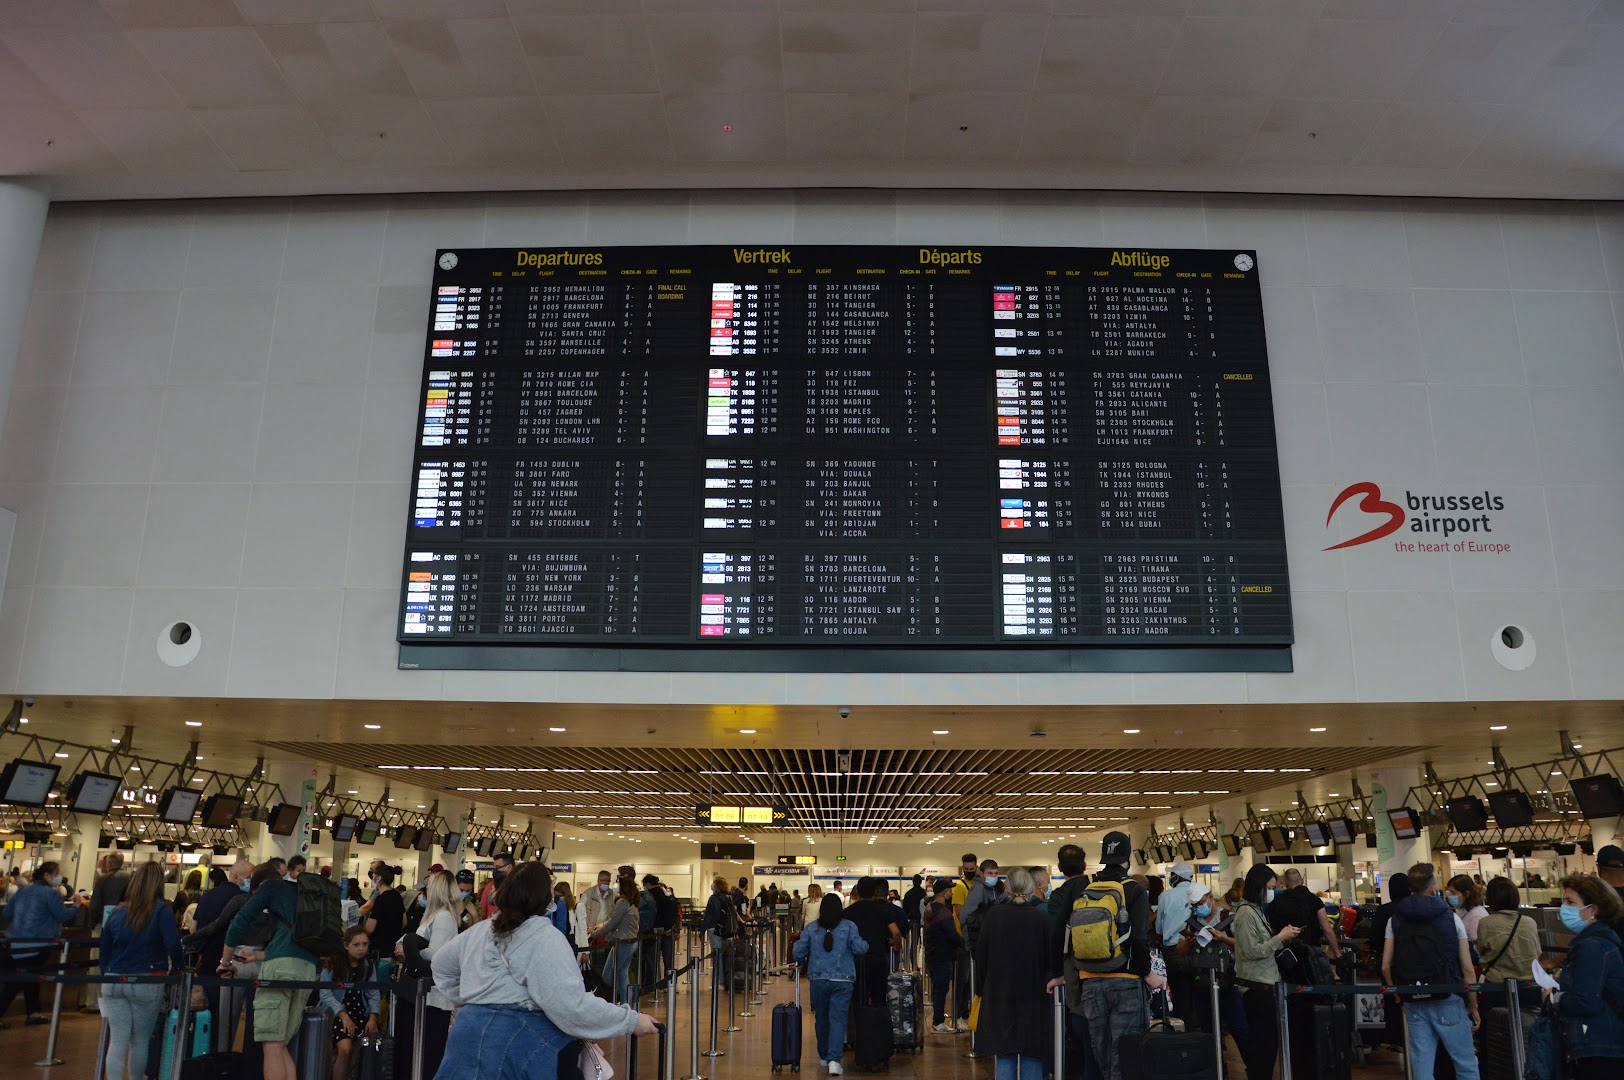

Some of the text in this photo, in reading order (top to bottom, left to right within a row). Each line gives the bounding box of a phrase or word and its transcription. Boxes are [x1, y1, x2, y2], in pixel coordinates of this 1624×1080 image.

[517, 251, 603, 268] Departures
[733, 248, 791, 263] Vertrek
[919, 248, 982, 267] Départs
[1111, 251, 1170, 270] Abflüge
[1127, 349, 1155, 357] MUNICH
[1223, 373, 1253, 381] CANCELLED
[1136, 491, 1170, 499] MYKONOS
[1406, 491, 1504, 511] brussels
[548, 519, 590, 527] STOCKHOLM
[1410, 512, 1492, 537] airport
[1395, 541, 1511, 554] the heart of Europe
[544, 574, 582, 582] NEW YORK
[544, 584, 573, 592] WARSAW
[843, 627, 867, 635] OUJDA
